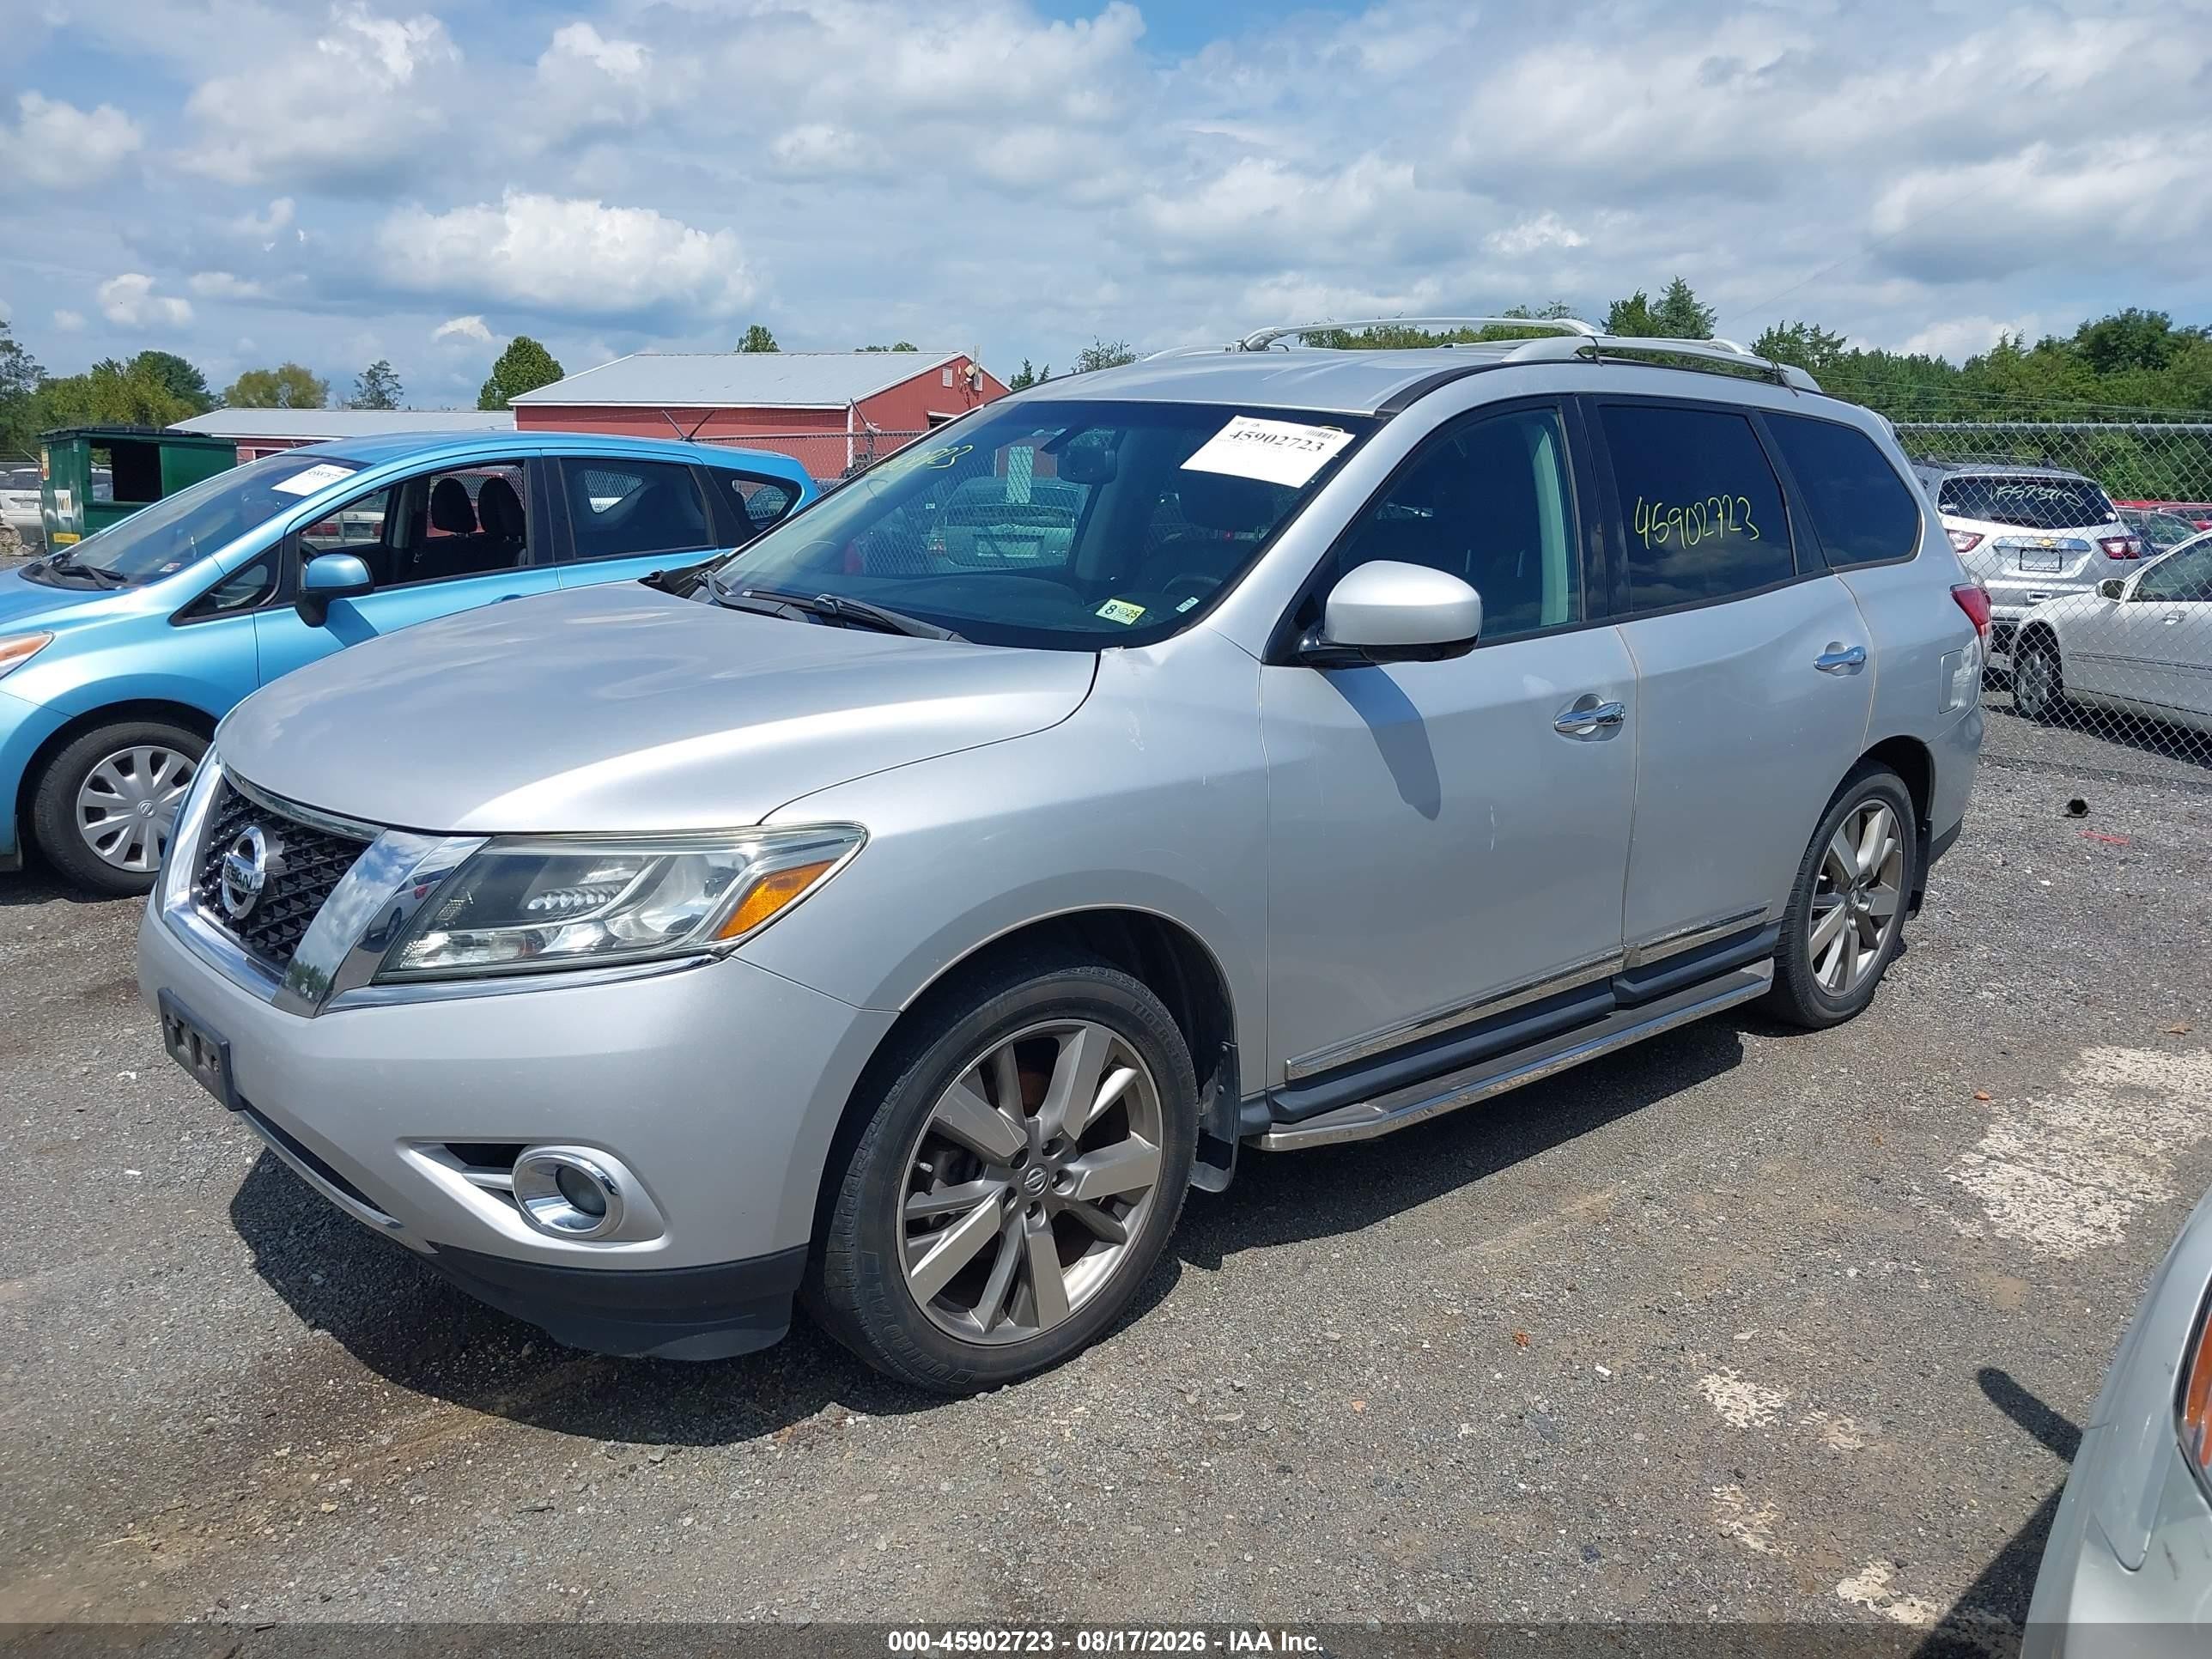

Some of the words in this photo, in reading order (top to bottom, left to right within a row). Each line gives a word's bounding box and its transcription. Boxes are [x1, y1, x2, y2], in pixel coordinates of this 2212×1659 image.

[1229, 429, 1325, 453] 45902723
[1635, 495, 1759, 550] 45902723
[1105, 605, 1118, 615] 8
[1126, 609, 1140, 619] 25
